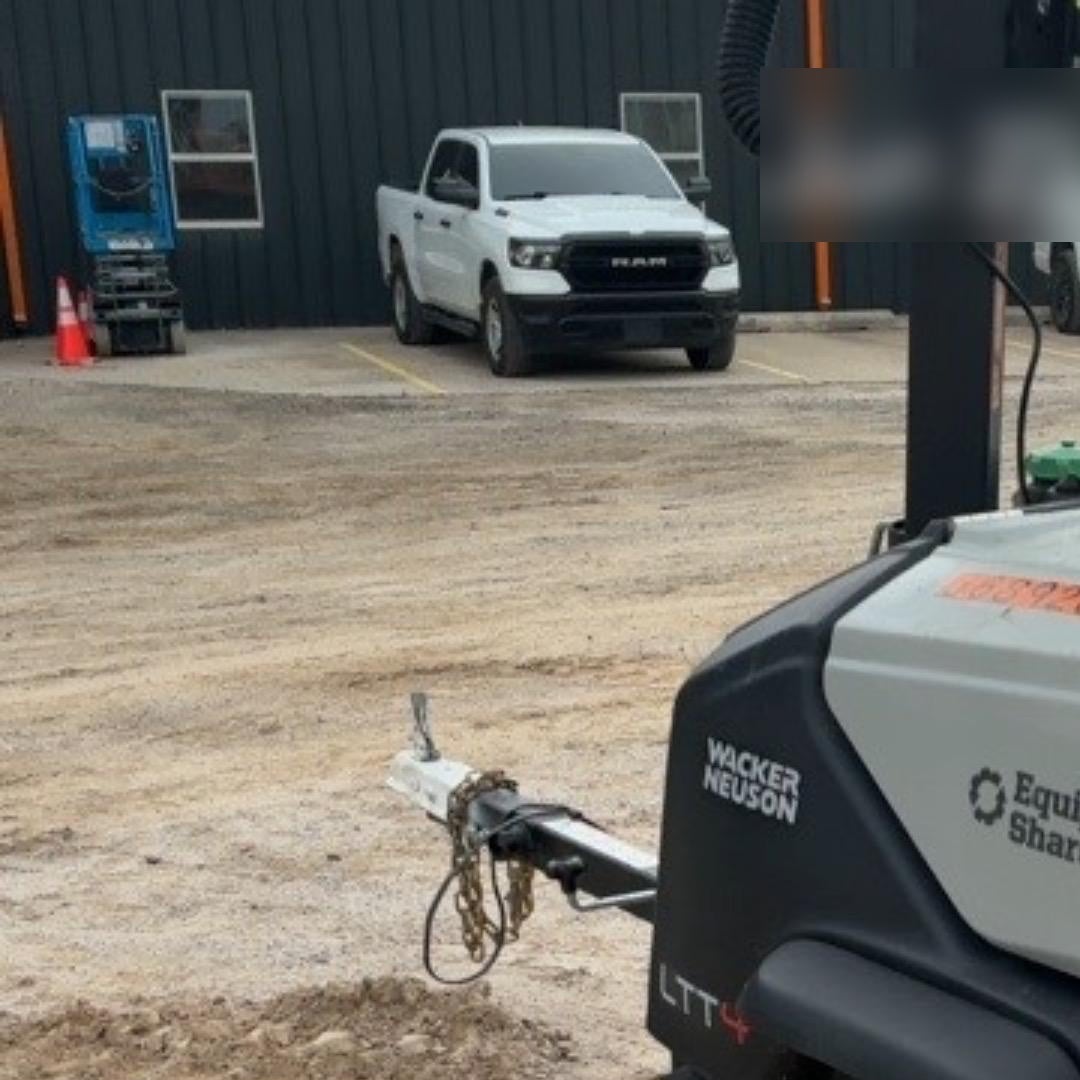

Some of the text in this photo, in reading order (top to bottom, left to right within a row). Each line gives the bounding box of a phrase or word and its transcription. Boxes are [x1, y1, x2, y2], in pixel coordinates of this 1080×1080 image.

[611, 256, 667, 268] RAM
[702, 763, 799, 825] NEUSON
[706, 736, 801, 798] WACKER
